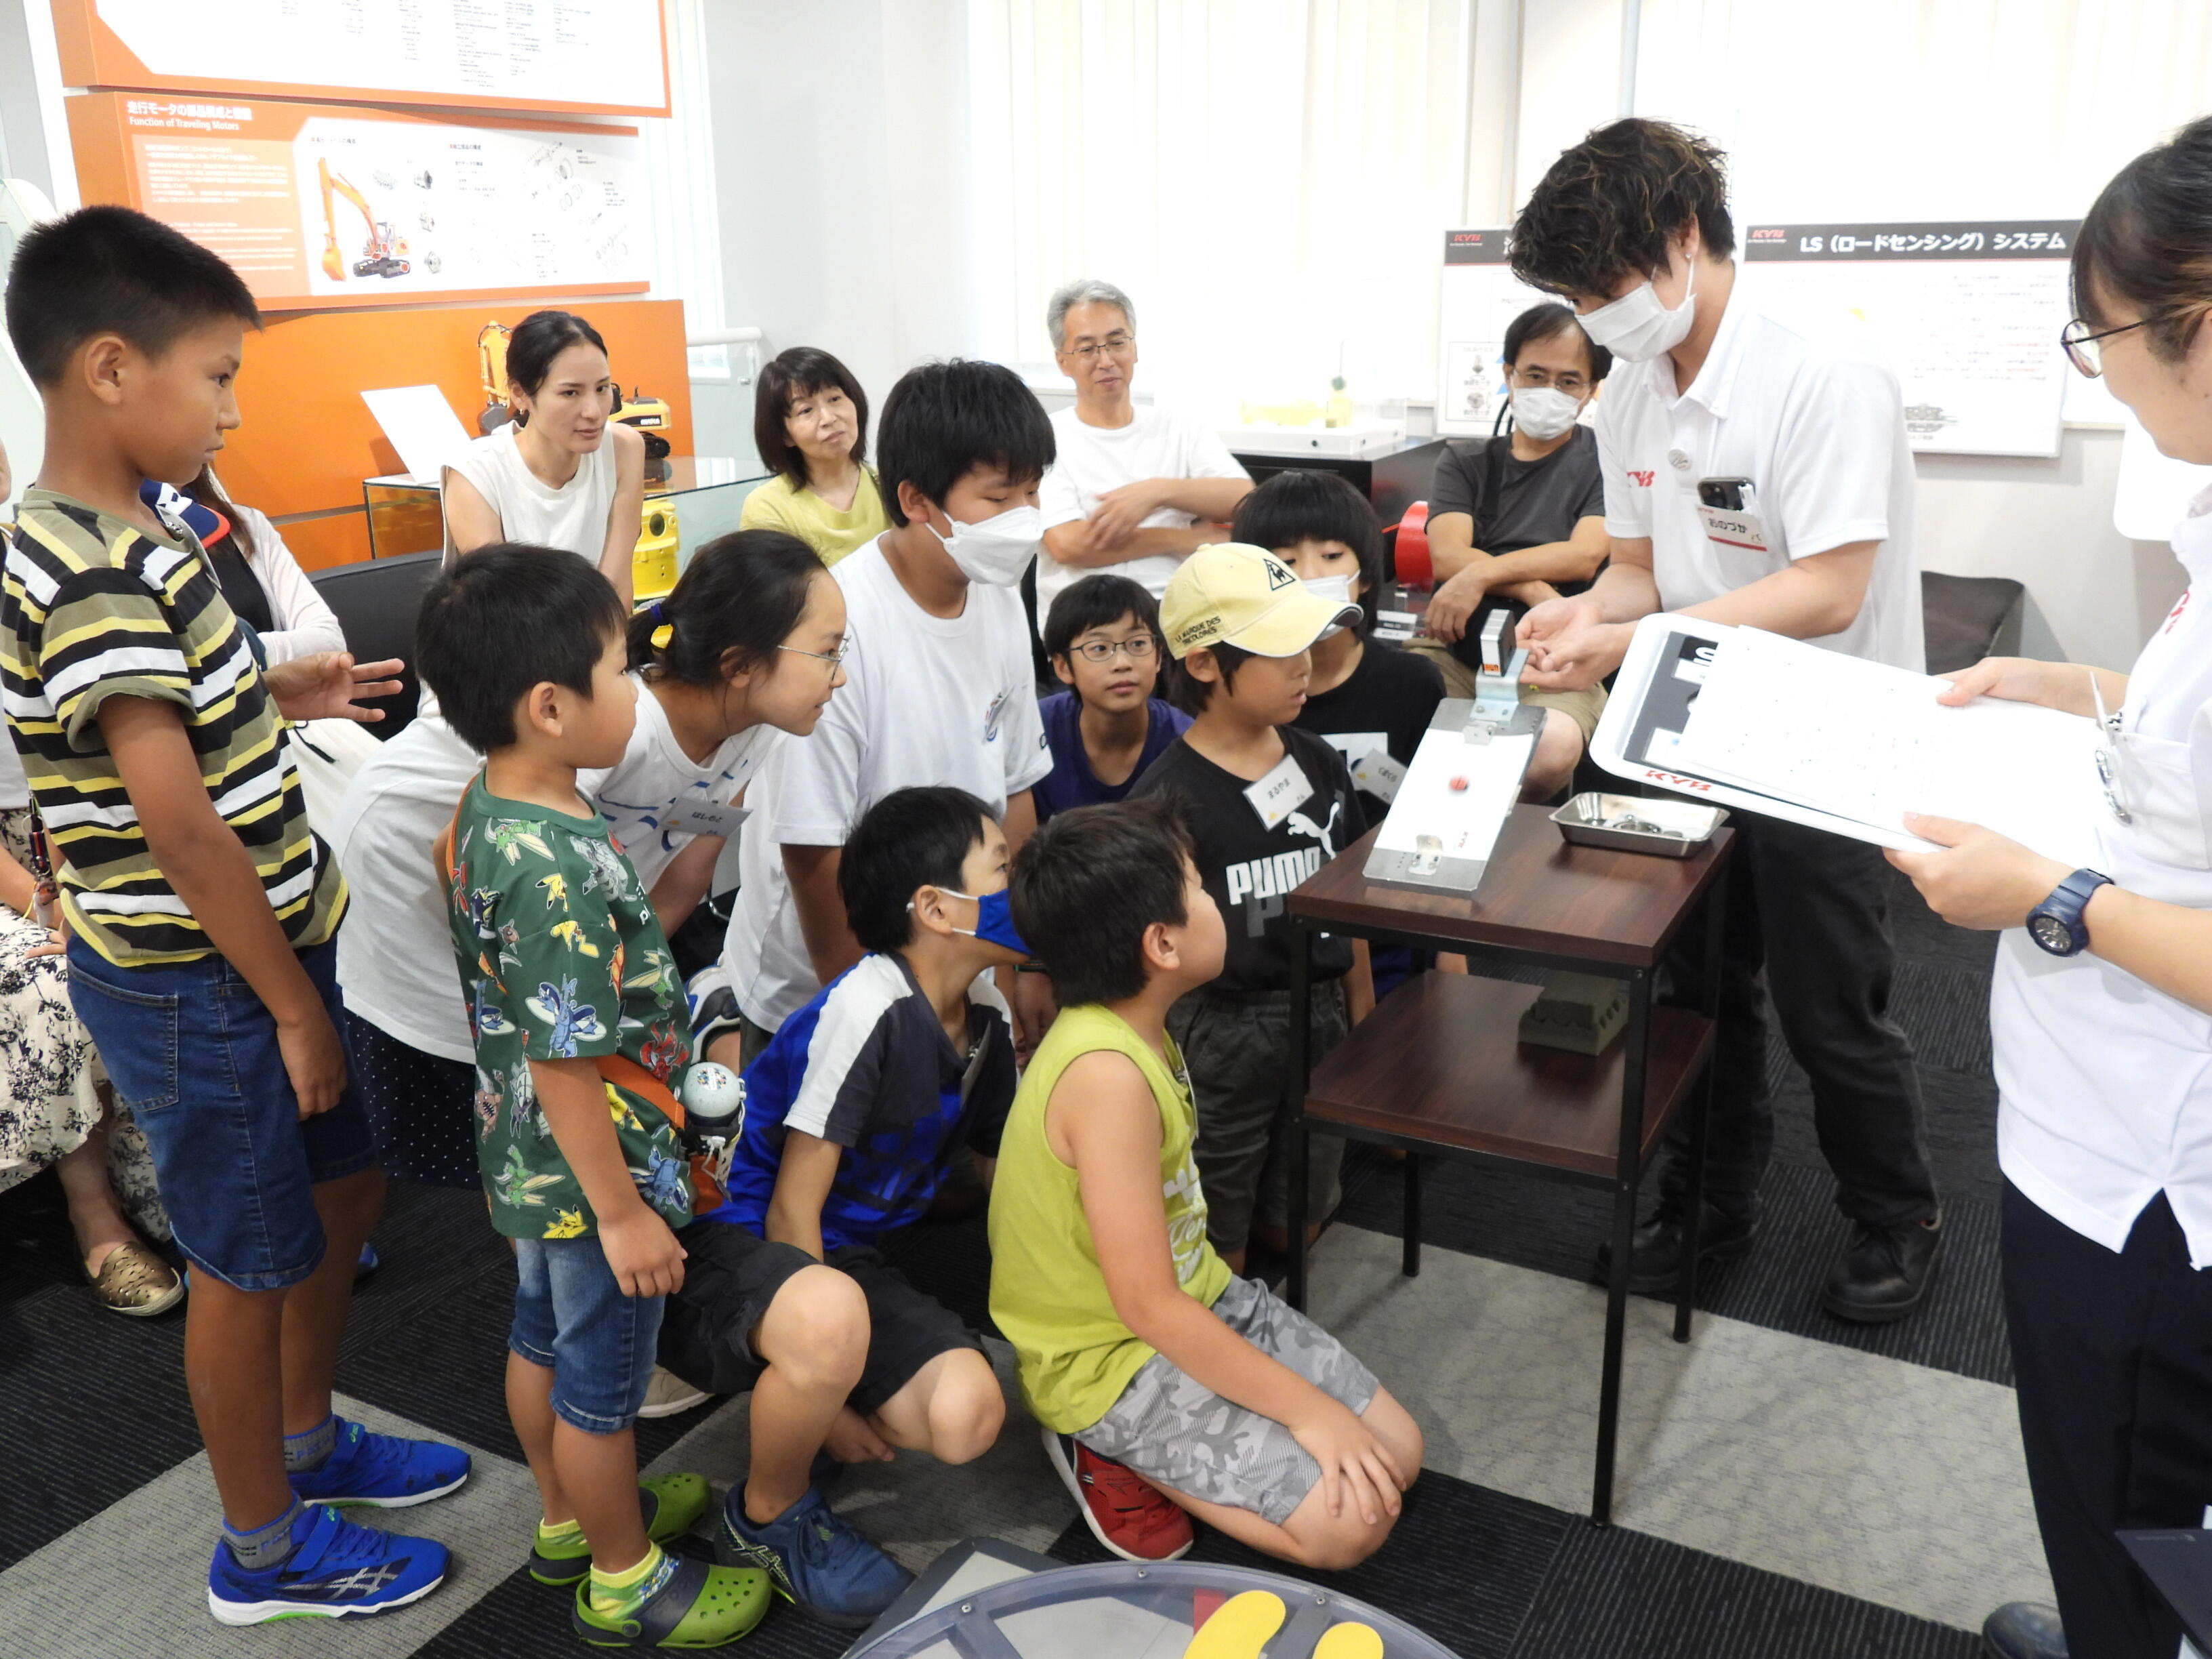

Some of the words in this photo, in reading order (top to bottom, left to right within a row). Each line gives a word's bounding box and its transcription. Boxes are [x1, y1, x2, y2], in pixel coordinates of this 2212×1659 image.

[129, 117, 164, 126] Function
[166, 118, 174, 127] of
[176, 119, 211, 130] Traveling
[212, 121, 239, 130] Motors
[1453, 234, 1482, 242] KYB
[1627, 471, 1656, 487] YB
[1206, 615, 1221, 627] DES
[1226, 846, 1321, 905] PUMA
